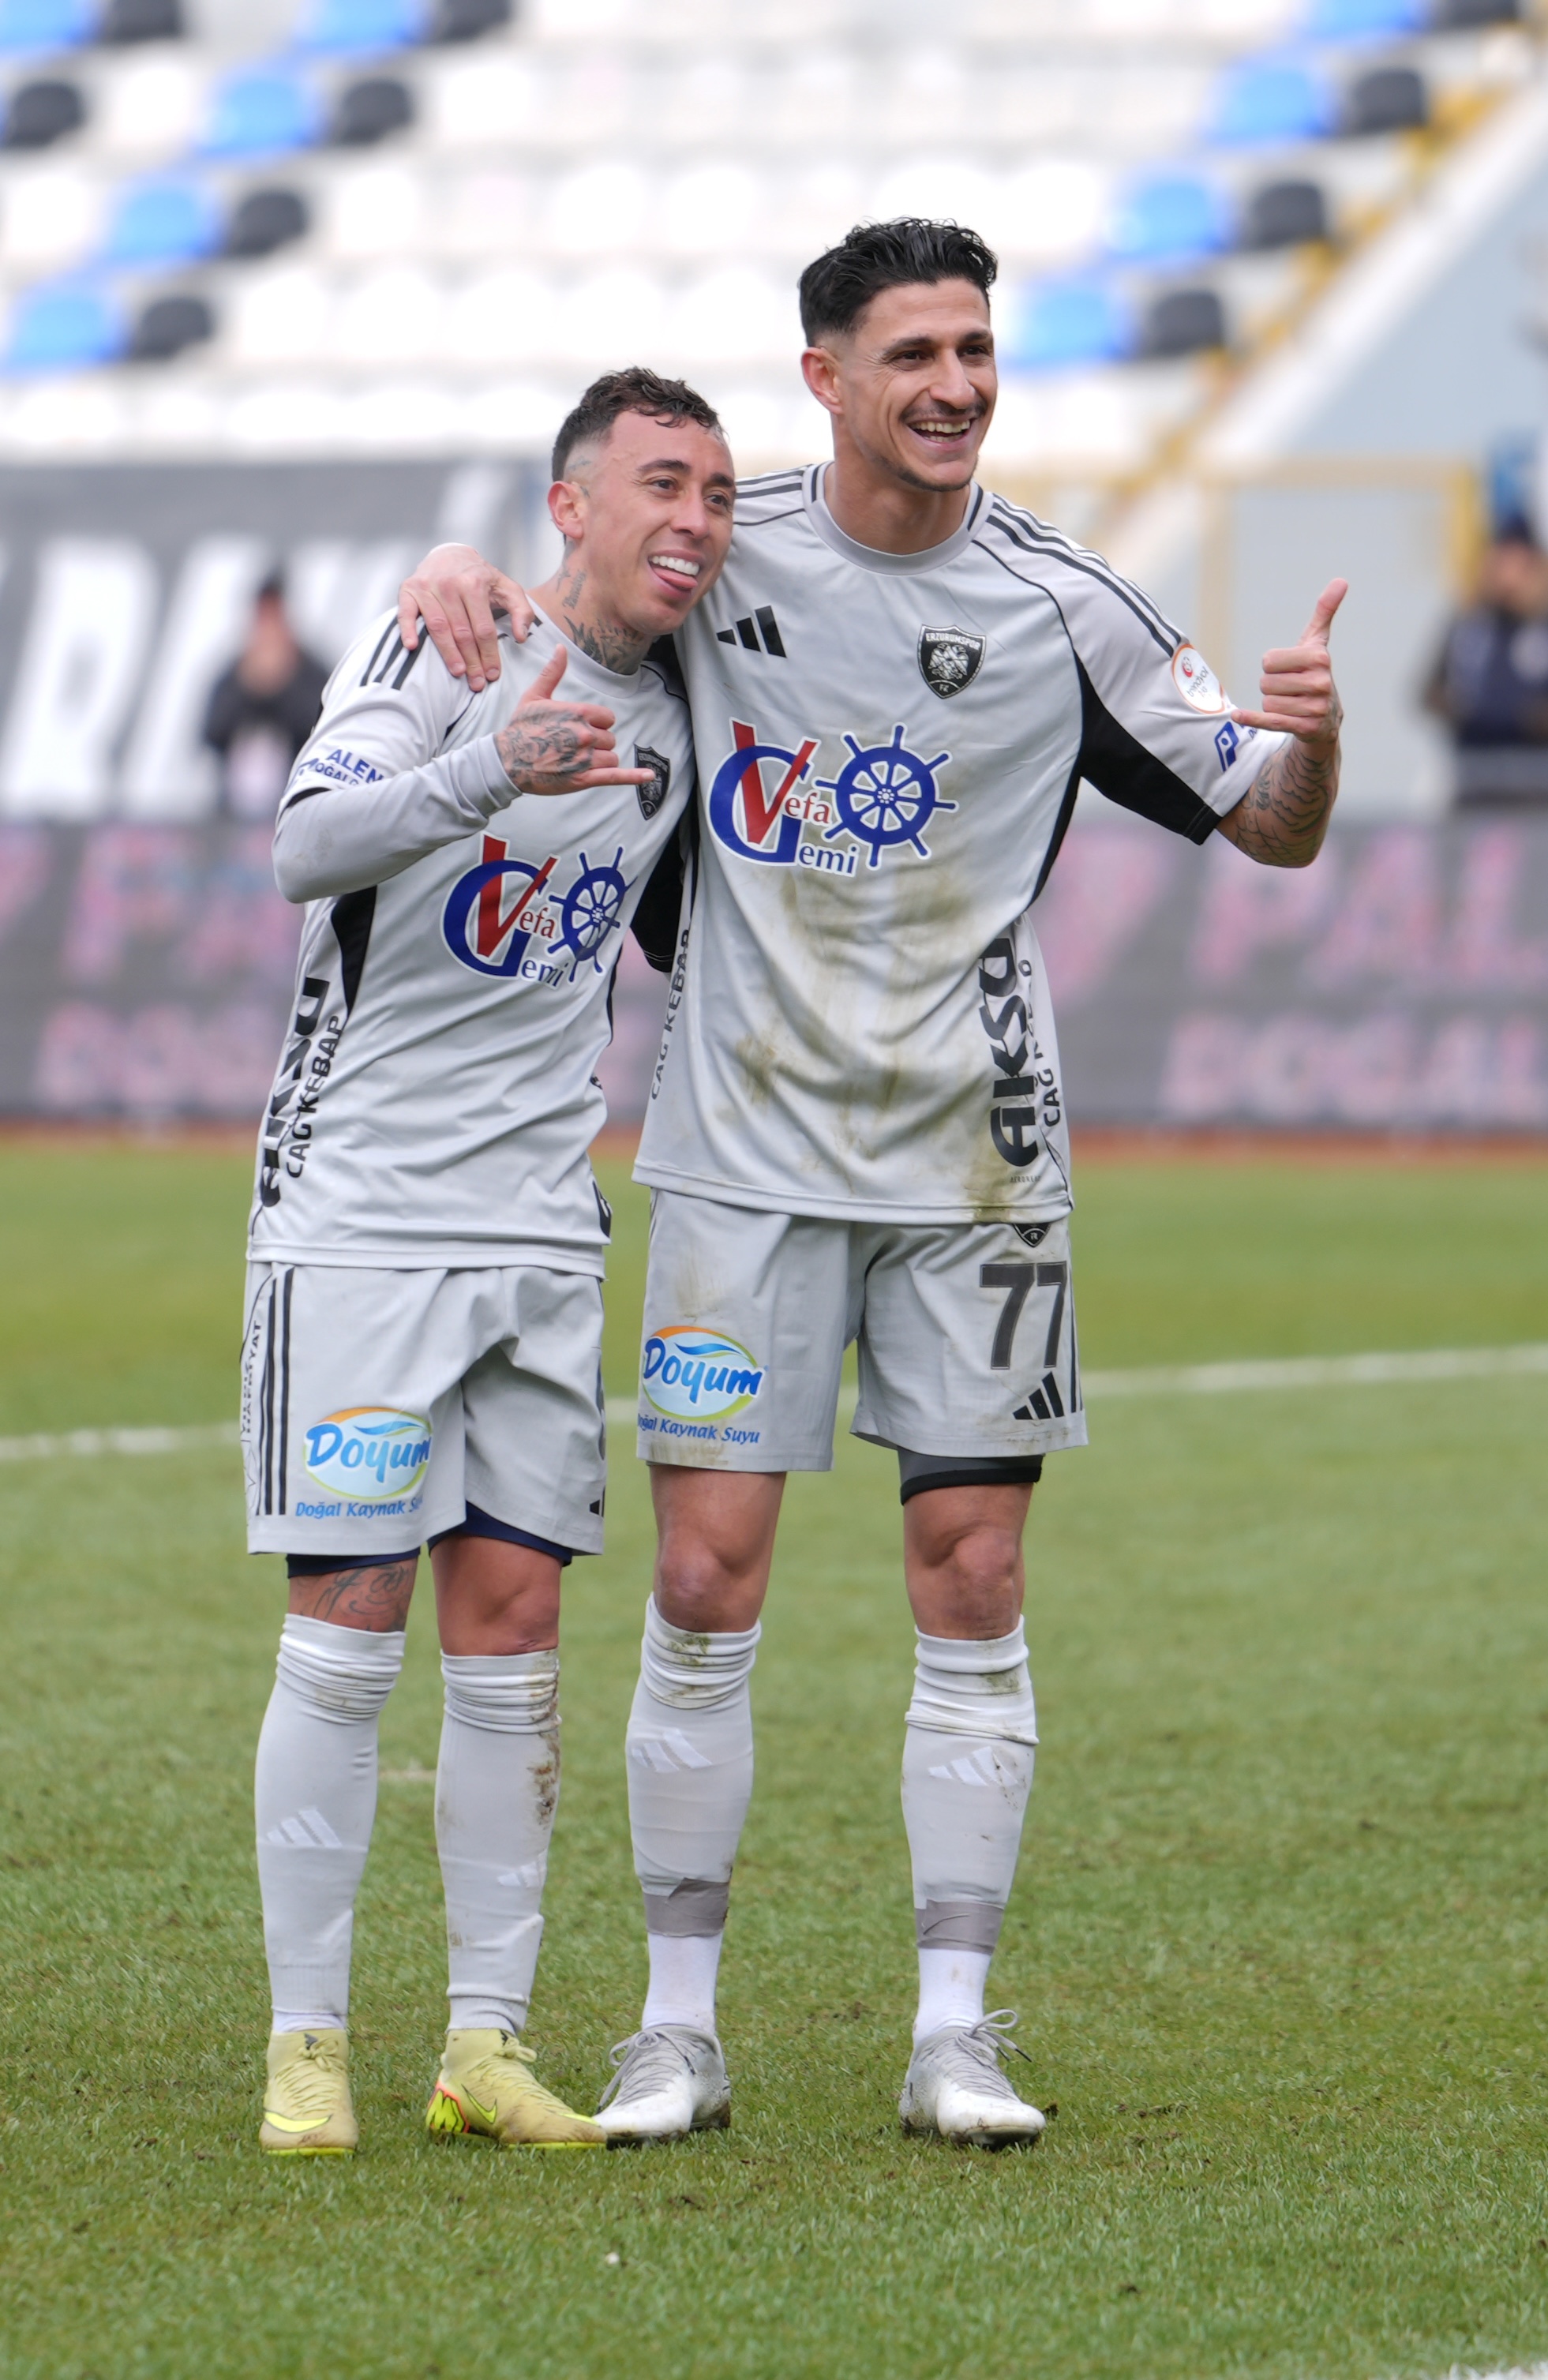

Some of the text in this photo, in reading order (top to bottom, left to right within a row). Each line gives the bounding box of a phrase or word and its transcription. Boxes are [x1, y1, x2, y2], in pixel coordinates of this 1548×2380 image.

[732, 720, 830, 845] Vefa
[477, 834, 559, 958] Vefa
[297, 1015, 343, 1114] KEBAP
[980, 1262, 1067, 1370] 77
[643, 1337, 763, 1404] Doyum
[305, 1423, 432, 1483] Doyum
[660, 1419, 718, 1440] Kaynak
[722, 1426, 761, 1445] Suyu
[295, 1501, 342, 1520] Doğal
[347, 1500, 407, 1519] Kaynak
